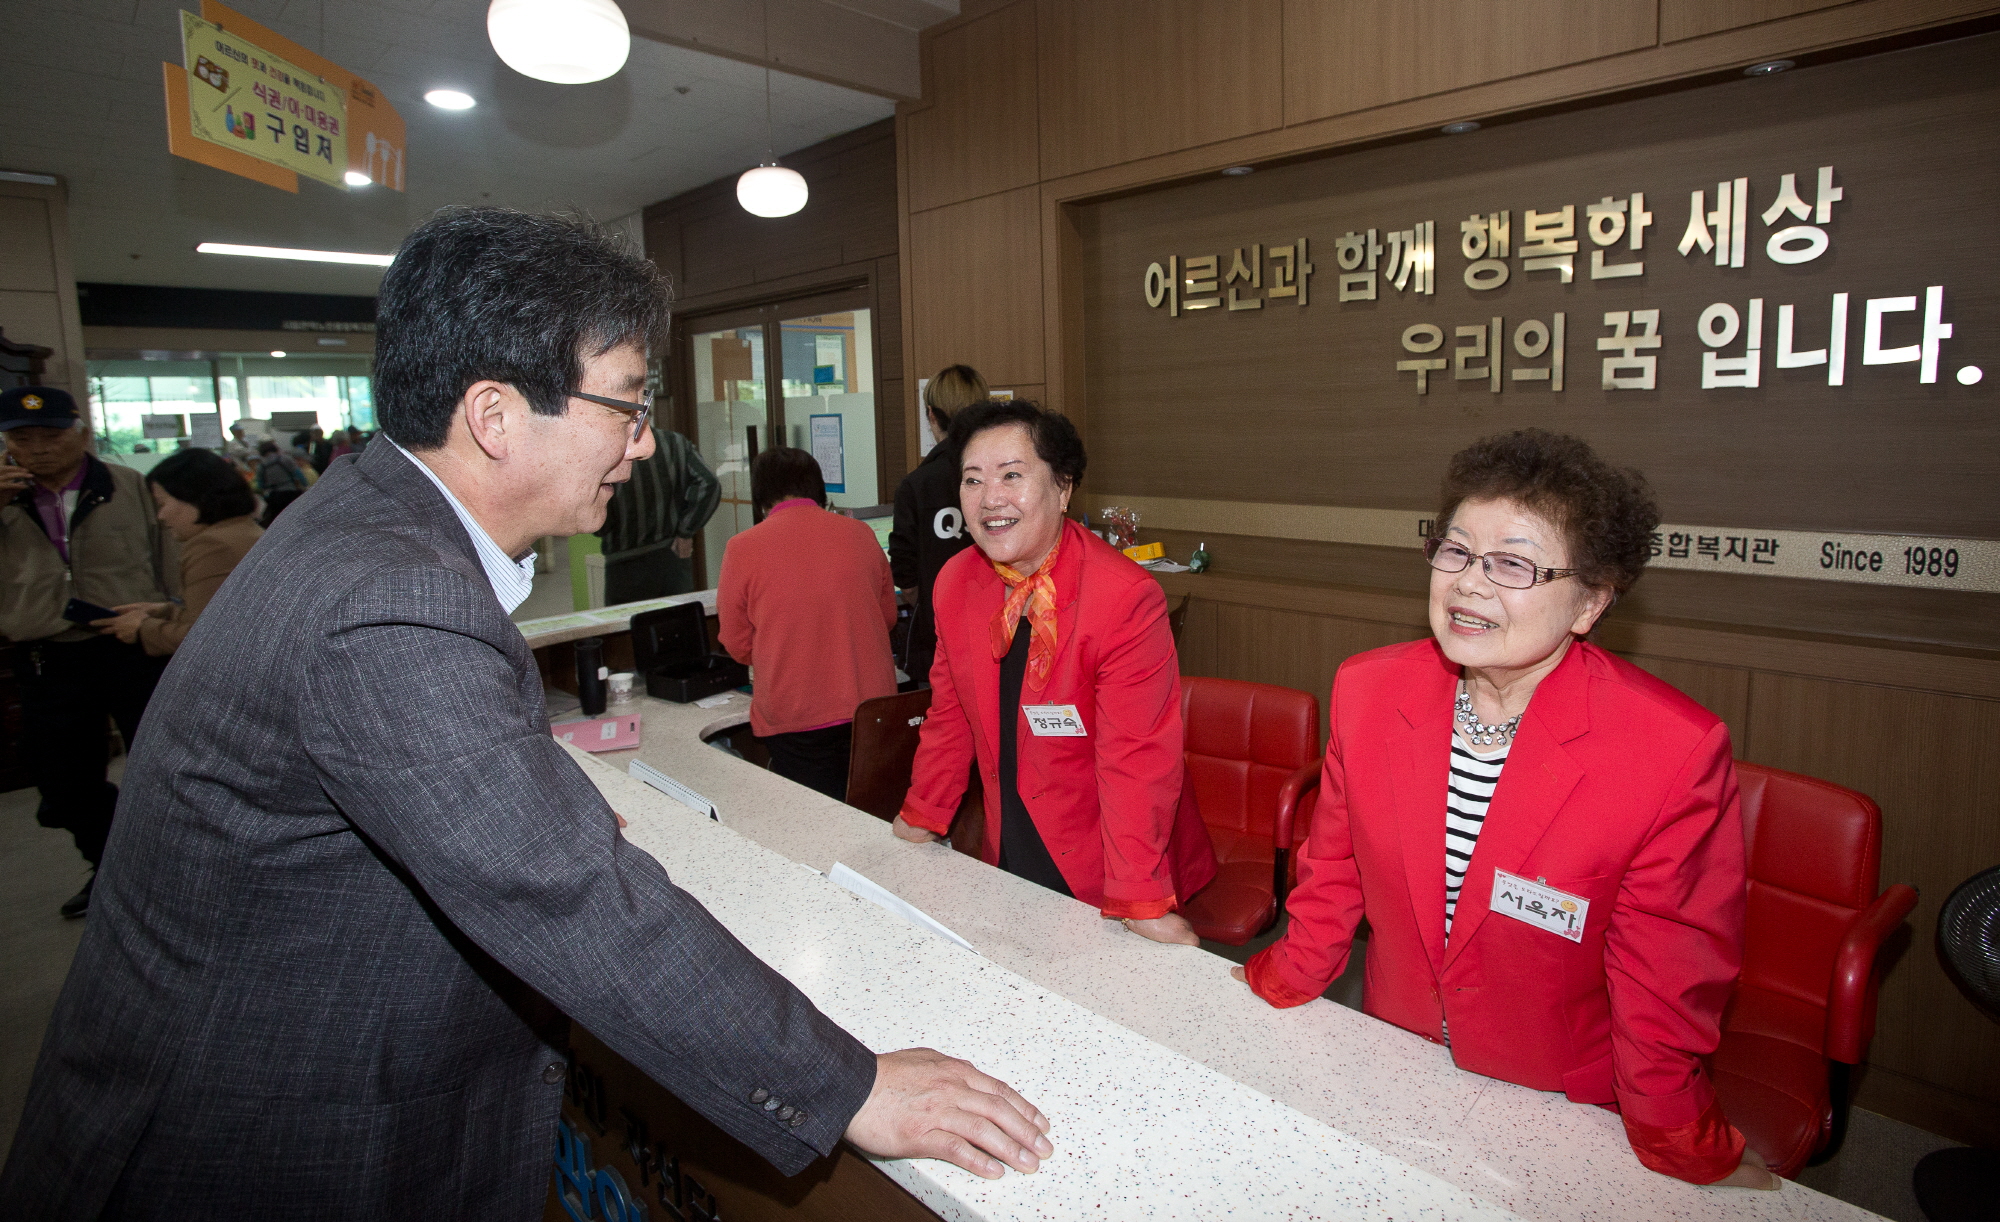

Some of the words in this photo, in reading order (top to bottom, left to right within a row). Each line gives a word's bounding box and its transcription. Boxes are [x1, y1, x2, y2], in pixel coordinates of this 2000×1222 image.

[1144, 237, 1314, 317] 어르신과
[1335, 219, 1435, 302] 함께
[1460, 192, 1653, 291] 행복한
[1677, 165, 1843, 268] 세상
[1397, 312, 1566, 395] 우리의
[1596, 308, 1662, 391] 꿈
[1697, 285, 1983, 389] 입니다.
[1819, 540, 1884, 574] Since
[1904, 545, 1961, 579] 1989
[1032, 717, 1078, 729] 정규숙
[1500, 890, 1577, 929] 서옥자
